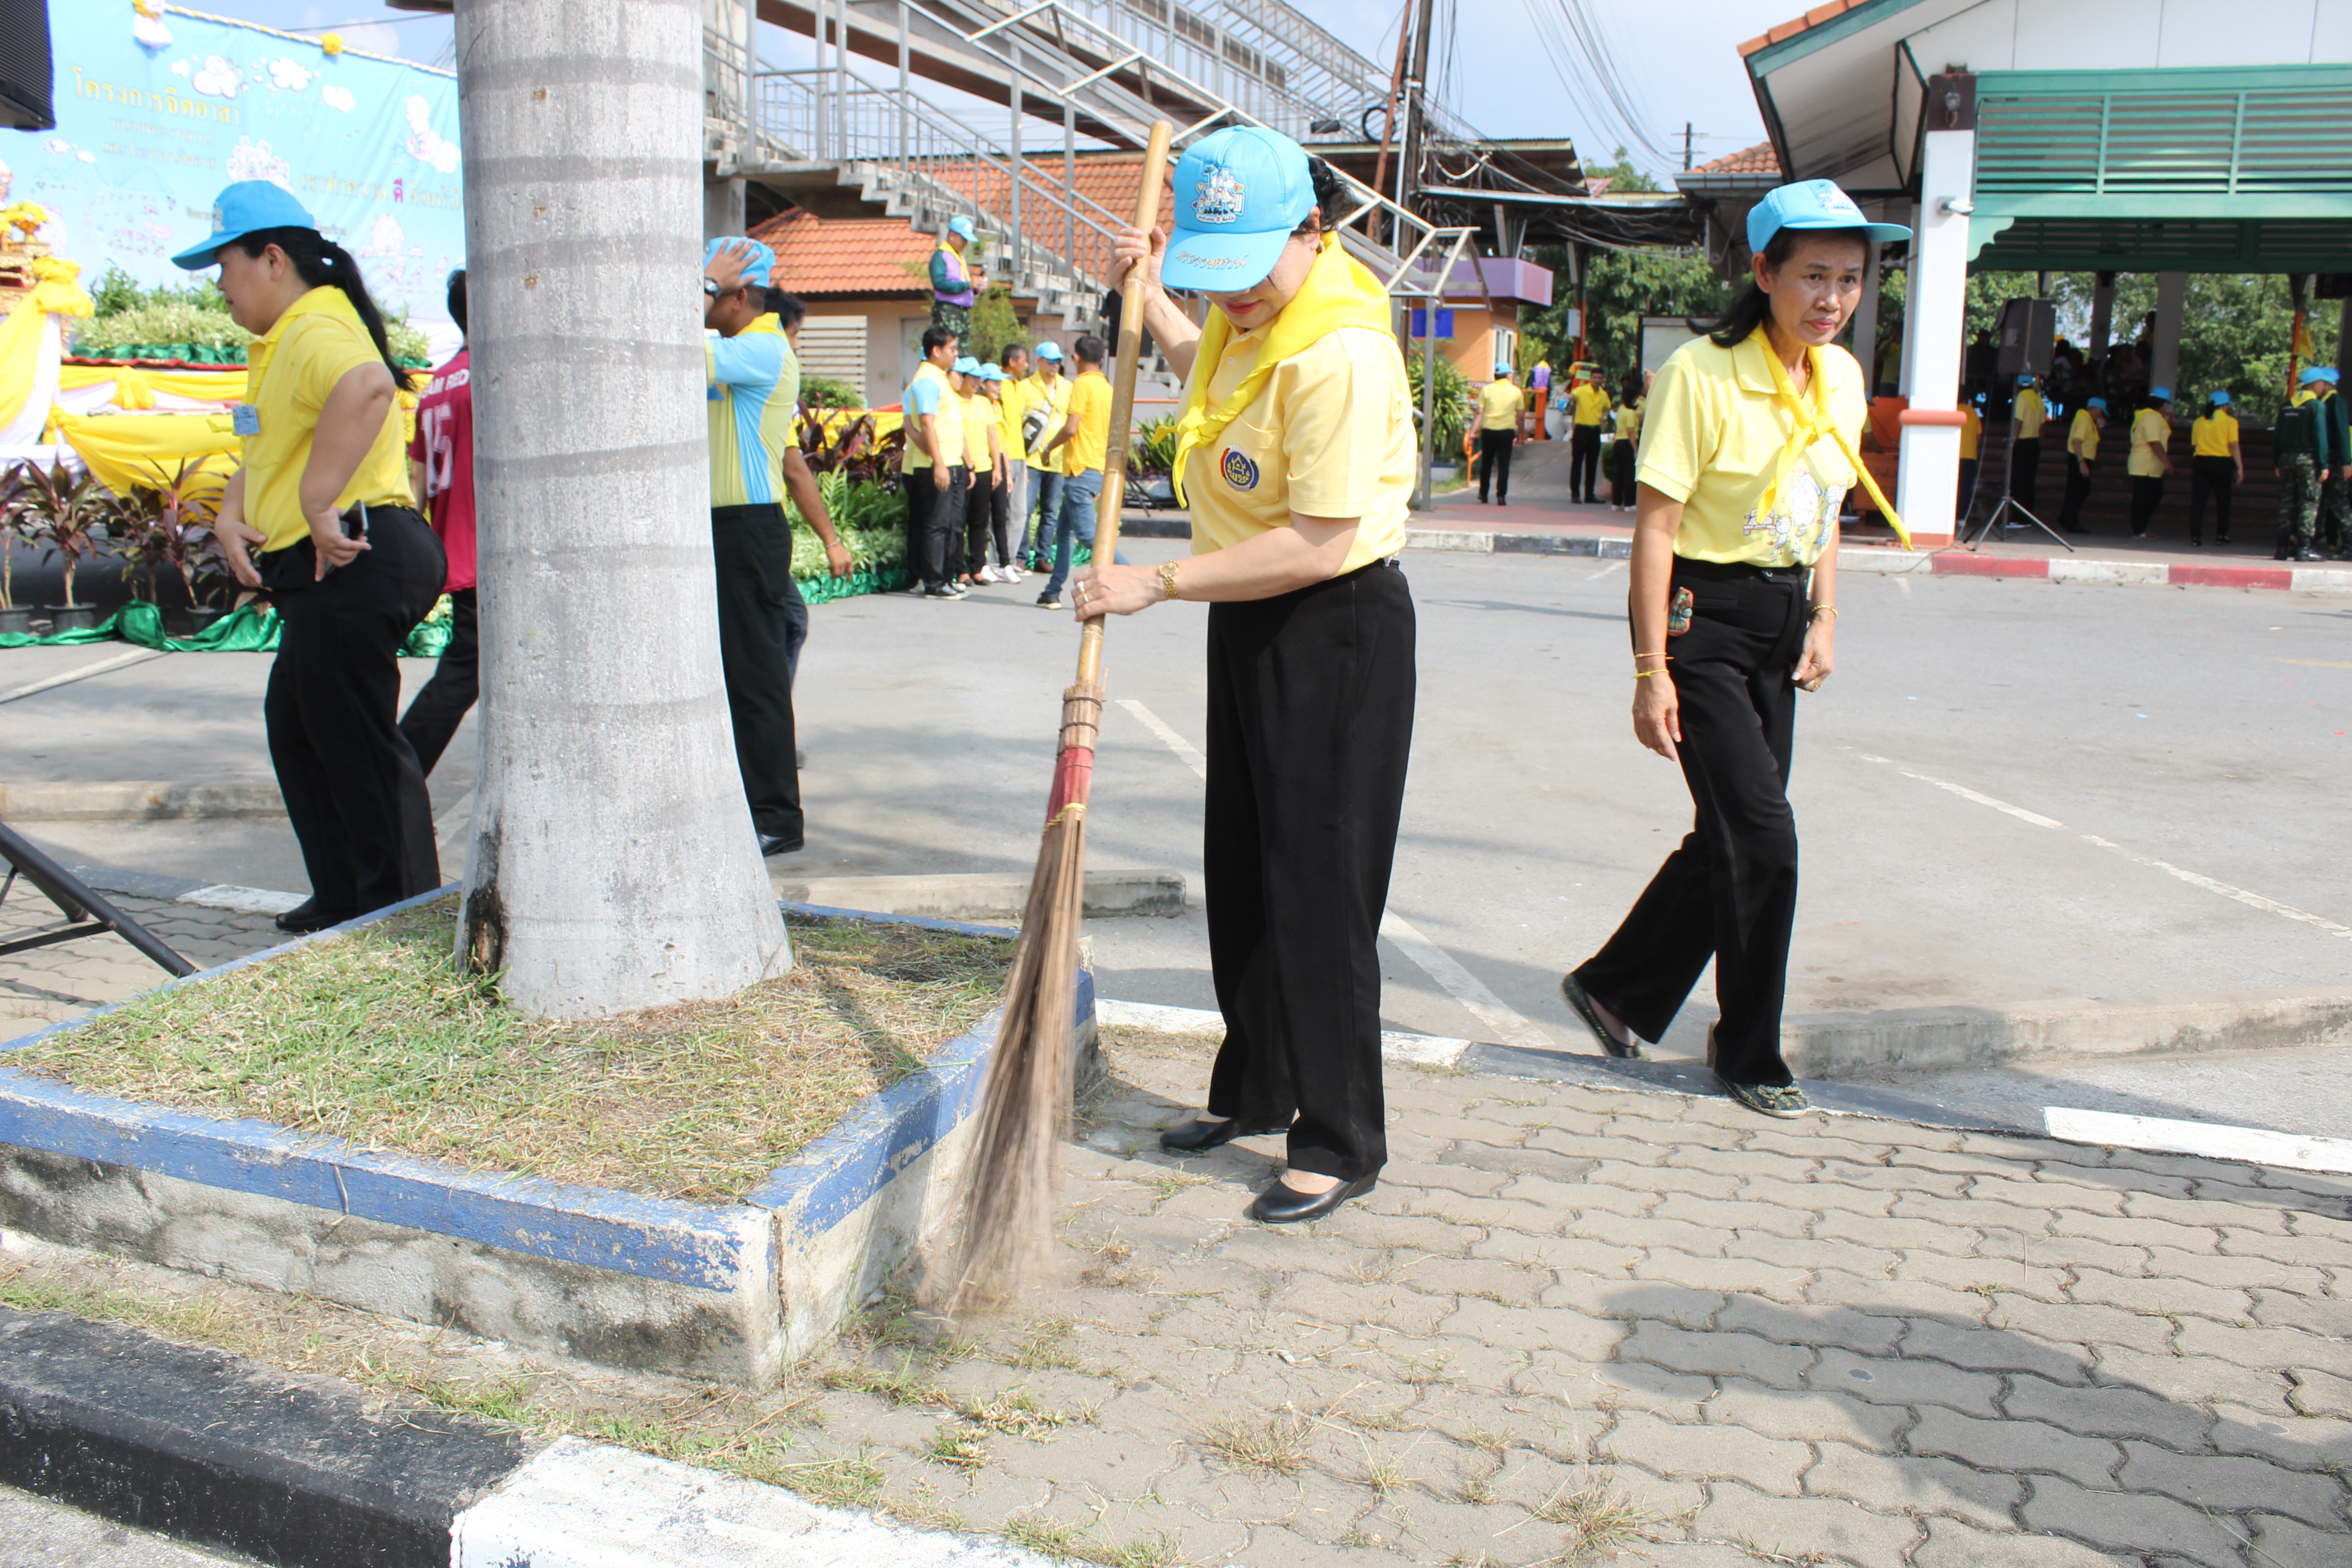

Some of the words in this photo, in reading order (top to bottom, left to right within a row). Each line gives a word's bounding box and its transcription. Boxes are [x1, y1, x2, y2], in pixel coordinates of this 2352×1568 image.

[72, 66, 240, 124] โครงการจิตอาสา
[301, 172, 387, 200] เราทำความ
[392, 177, 404, 203] ดี
[407, 180, 463, 209] ด้วยหัวใ
[421, 402, 453, 497] 15
